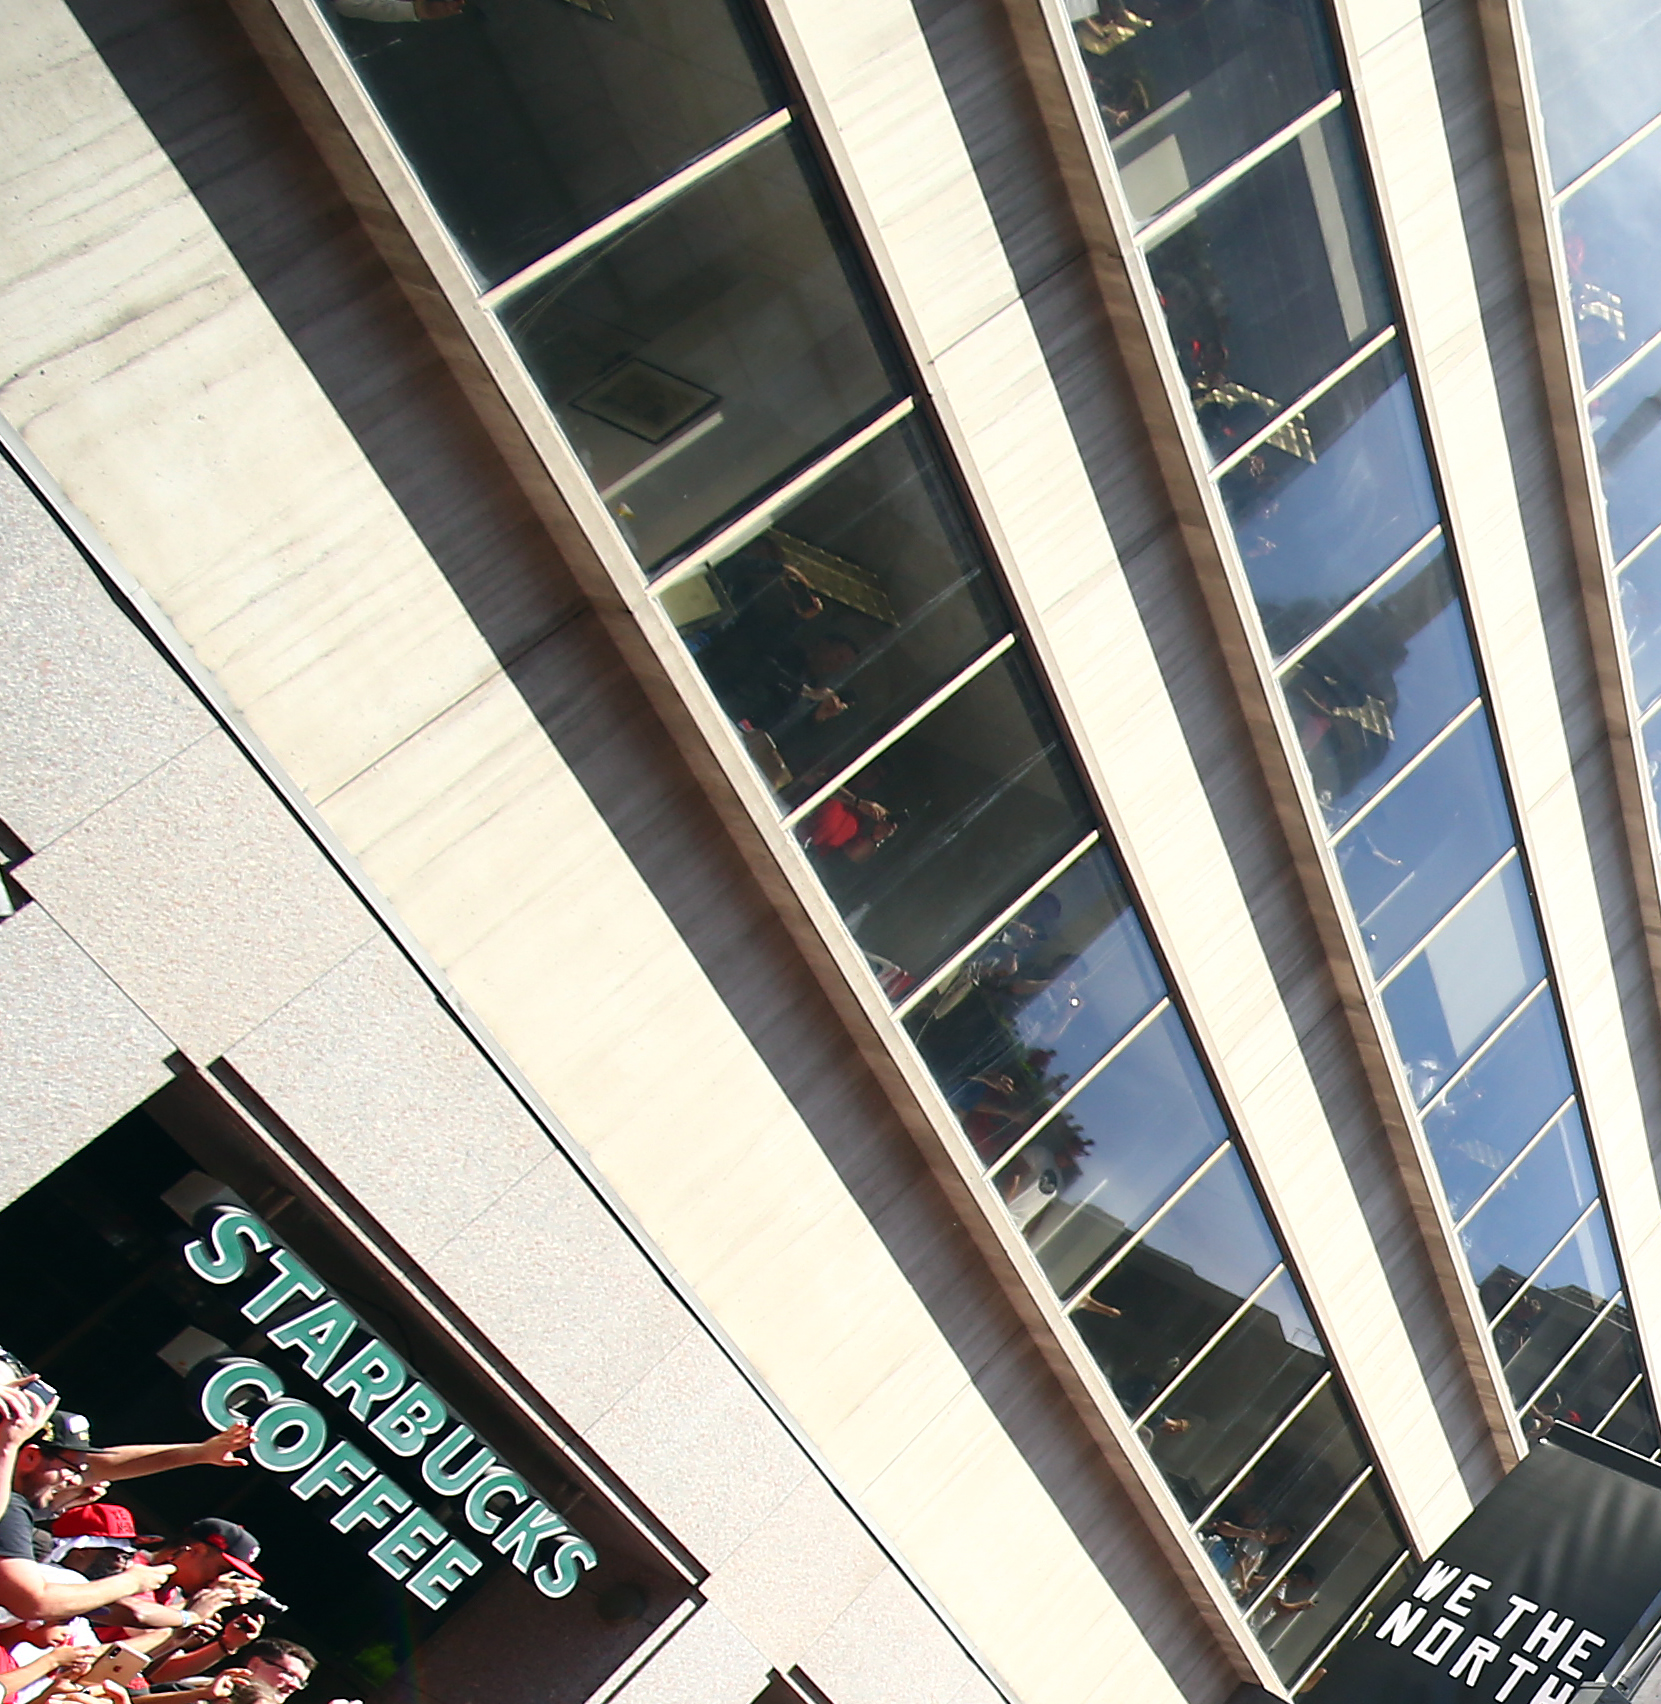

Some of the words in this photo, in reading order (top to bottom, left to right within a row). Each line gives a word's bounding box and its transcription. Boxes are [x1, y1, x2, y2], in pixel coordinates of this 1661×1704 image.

[184, 1206, 598, 1599] STARBUCKS
[201, 1360, 483, 1610] COFFEE
[1413, 1559, 1492, 1617] WE
[1493, 1594, 1605, 1680] THE
